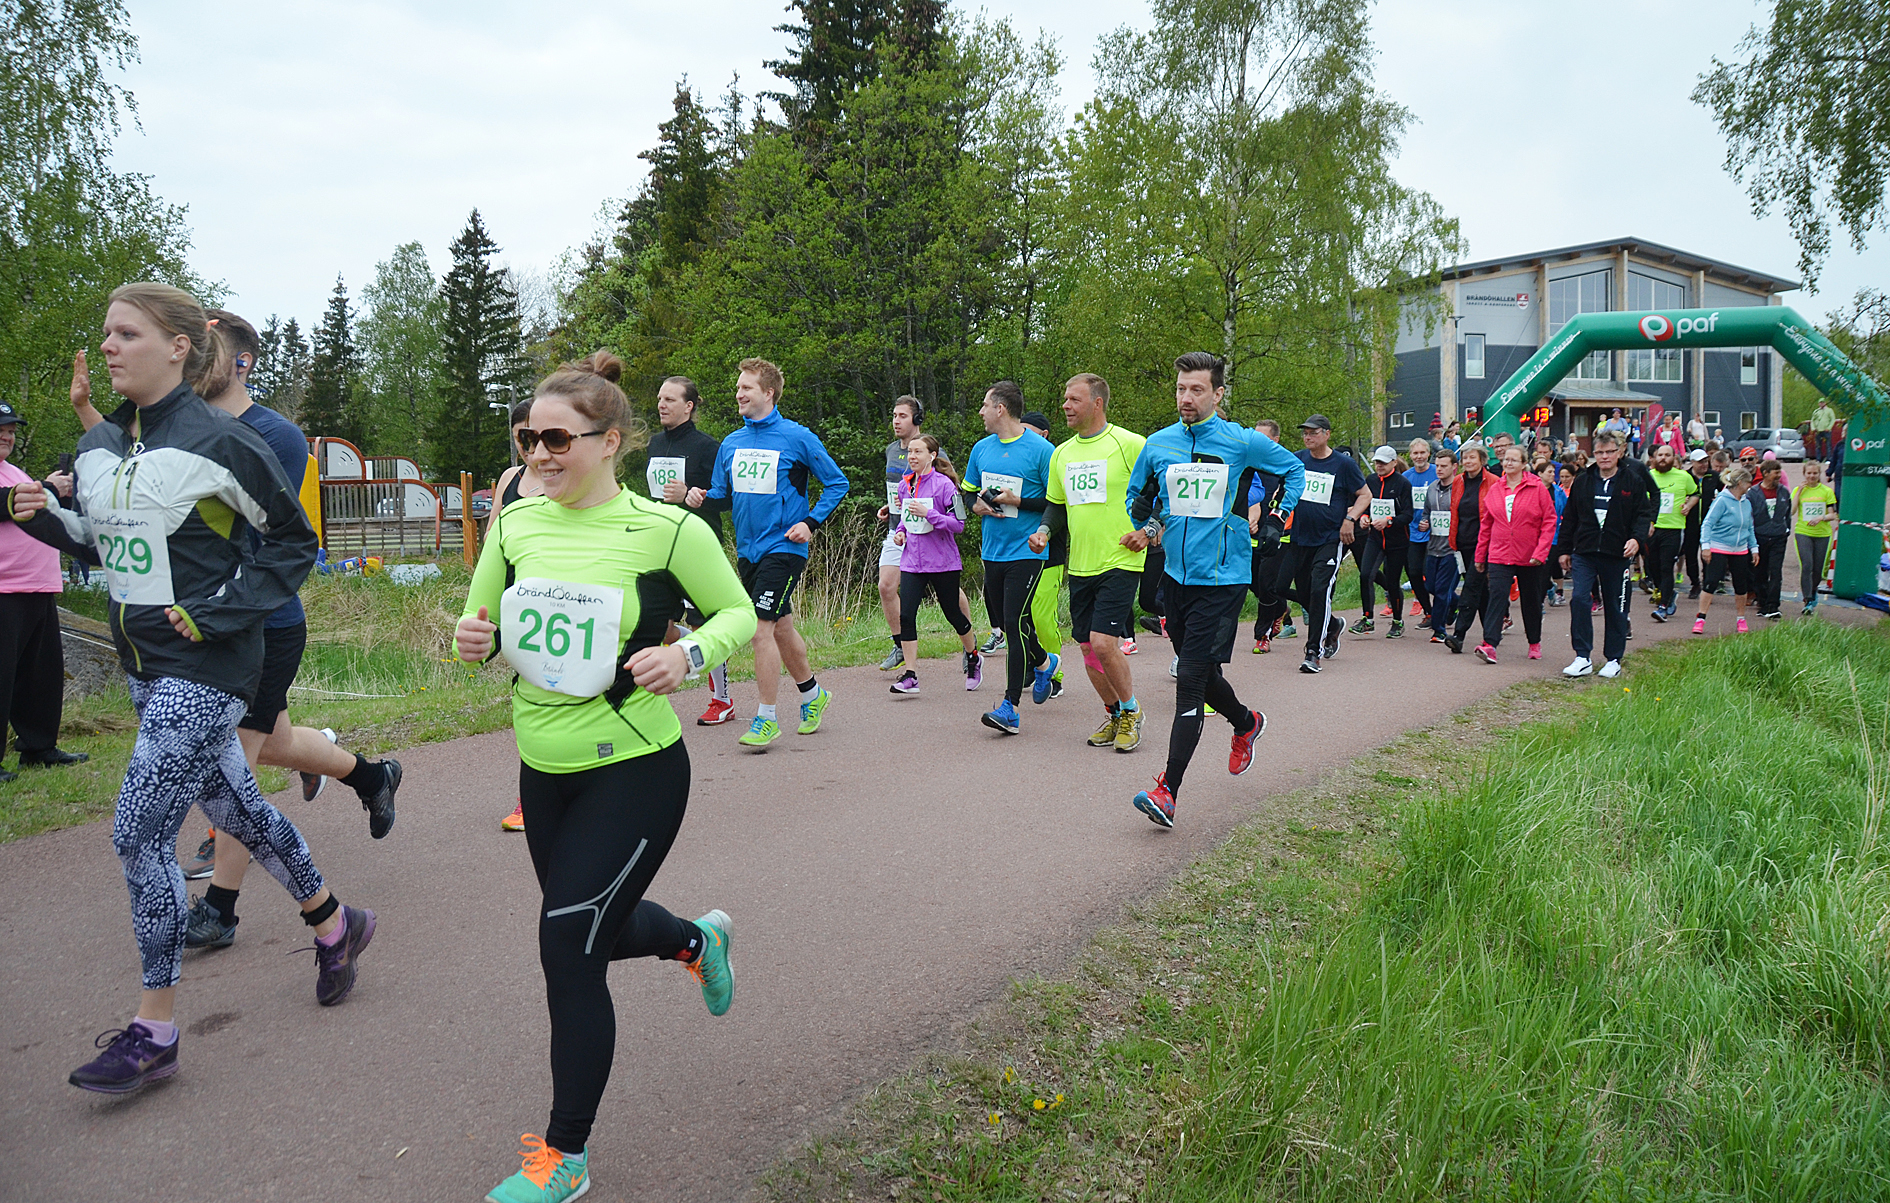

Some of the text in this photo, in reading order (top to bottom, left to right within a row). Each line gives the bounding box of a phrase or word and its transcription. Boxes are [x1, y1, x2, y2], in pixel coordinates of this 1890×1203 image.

[1677, 312, 1719, 339] paf
[1866, 438, 1885, 451] paf
[652, 469, 677, 485] 188
[737, 461, 771, 479] 247
[1070, 472, 1098, 491] 185
[1176, 478, 1217, 500] 217
[1306, 480, 1326, 494] 191
[1373, 505, 1391, 516] 253
[1805, 507, 1823, 516] 226
[1432, 518, 1450, 528] 243
[99, 533, 153, 575] 229
[517, 608, 595, 660] 261
